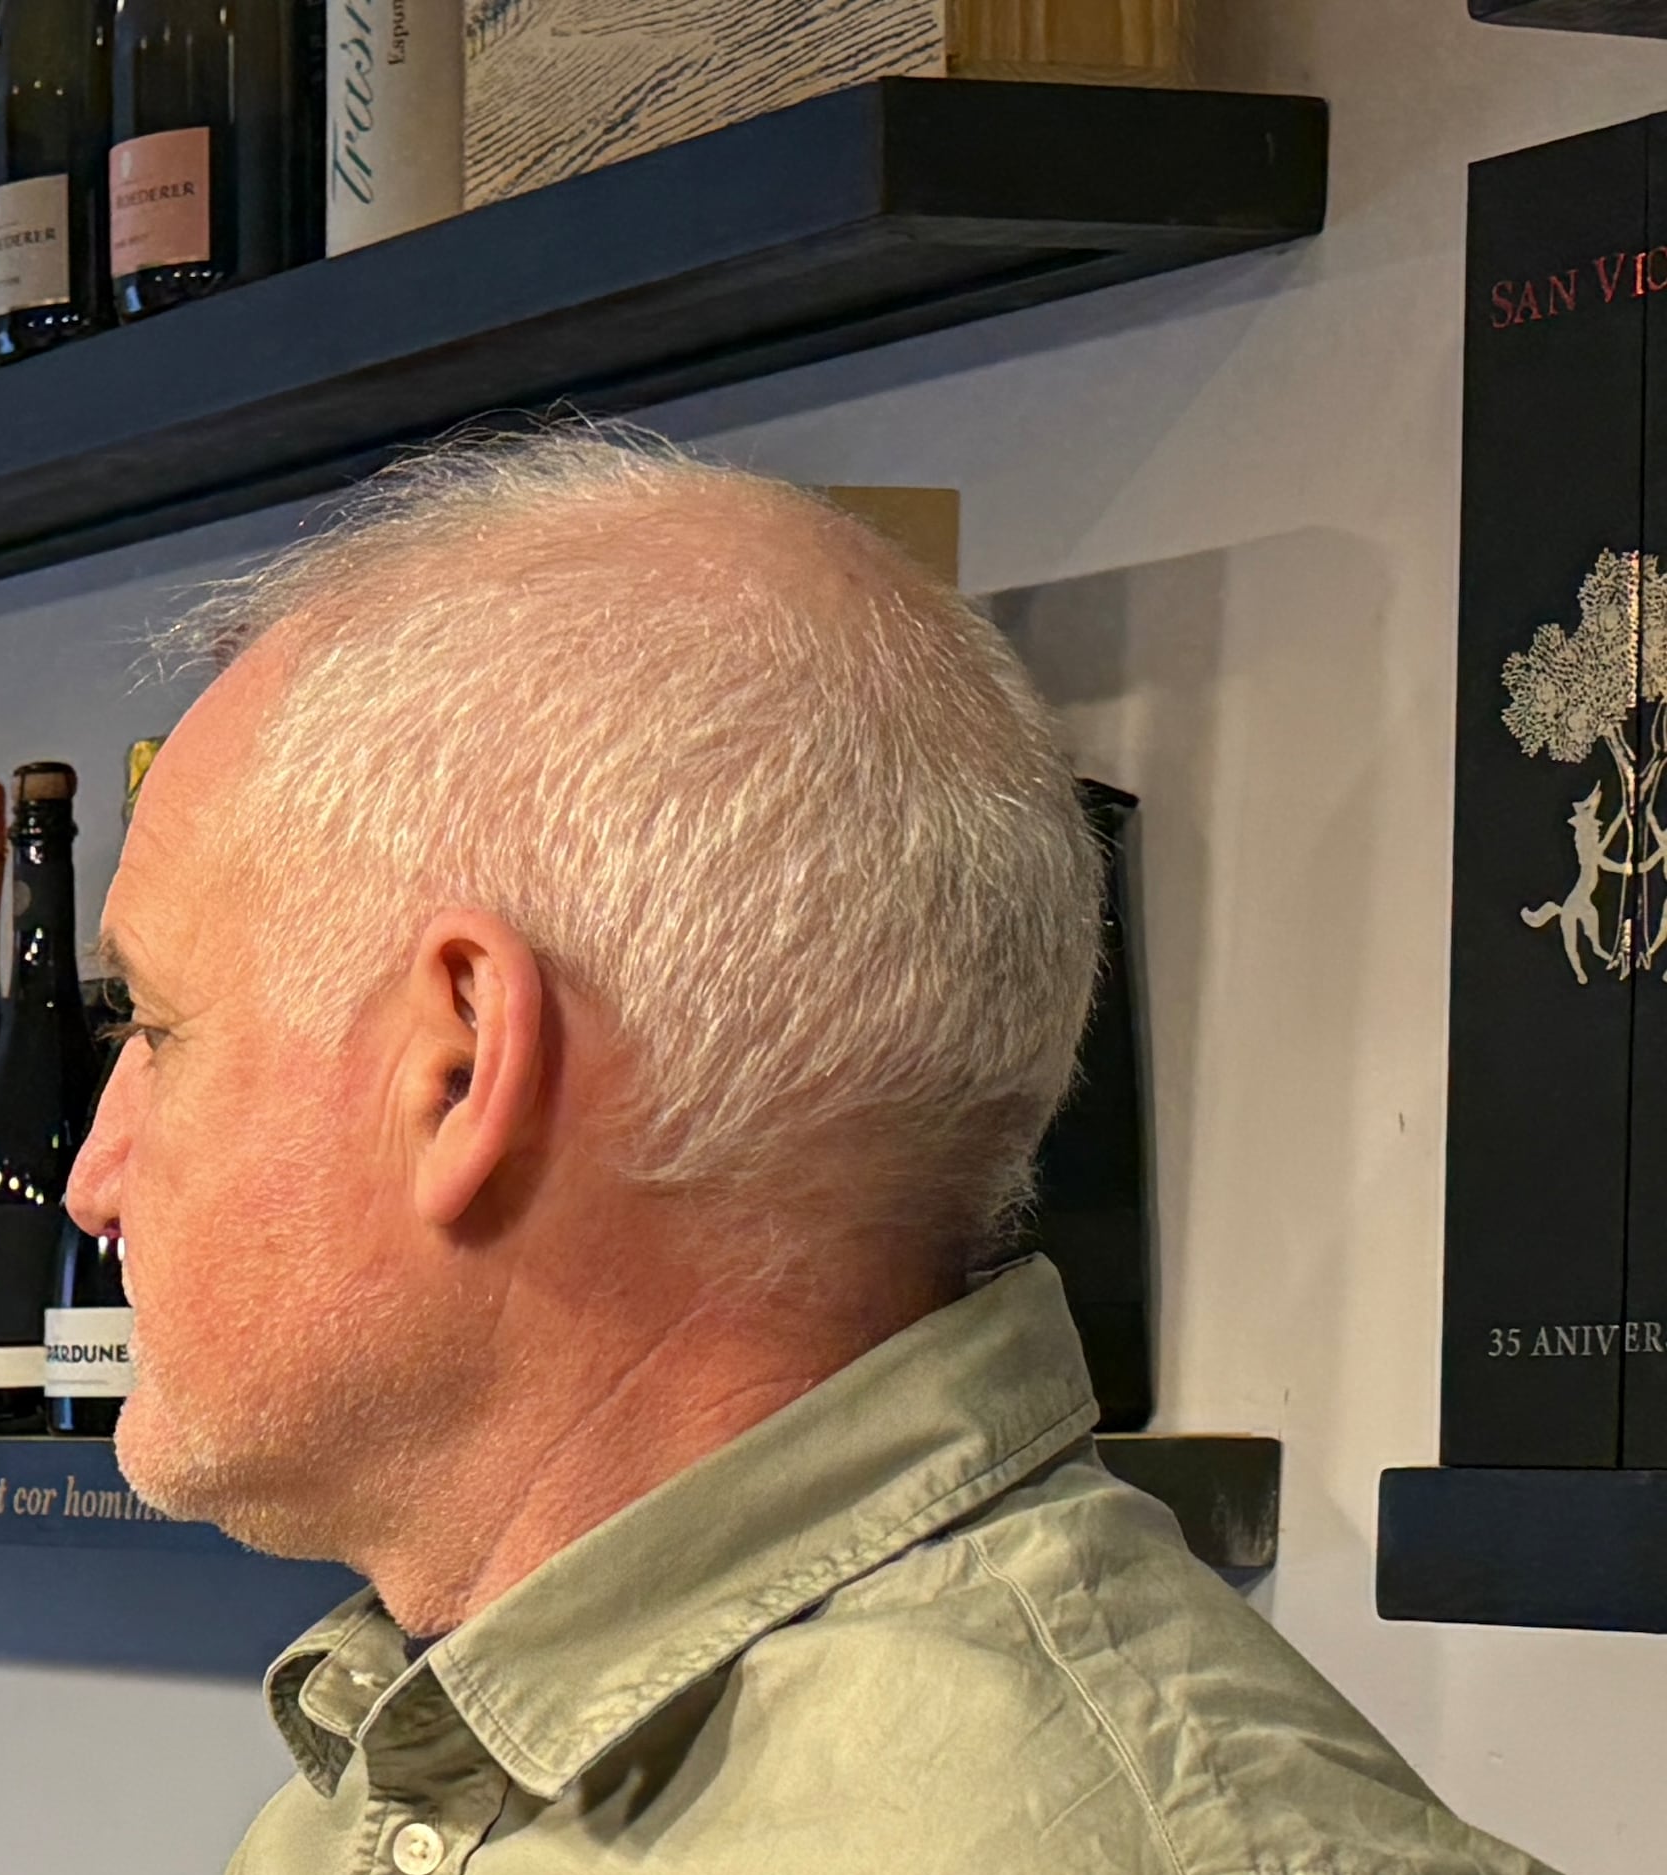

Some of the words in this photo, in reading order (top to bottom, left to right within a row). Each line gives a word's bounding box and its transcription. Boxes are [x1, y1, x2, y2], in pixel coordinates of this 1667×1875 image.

[1490, 269, 1579, 329] SAN
[1488, 1328, 1521, 1357] 35
[1530, 1321, 1667, 1357] ANIVER
[13, 1486, 57, 1516] cor
